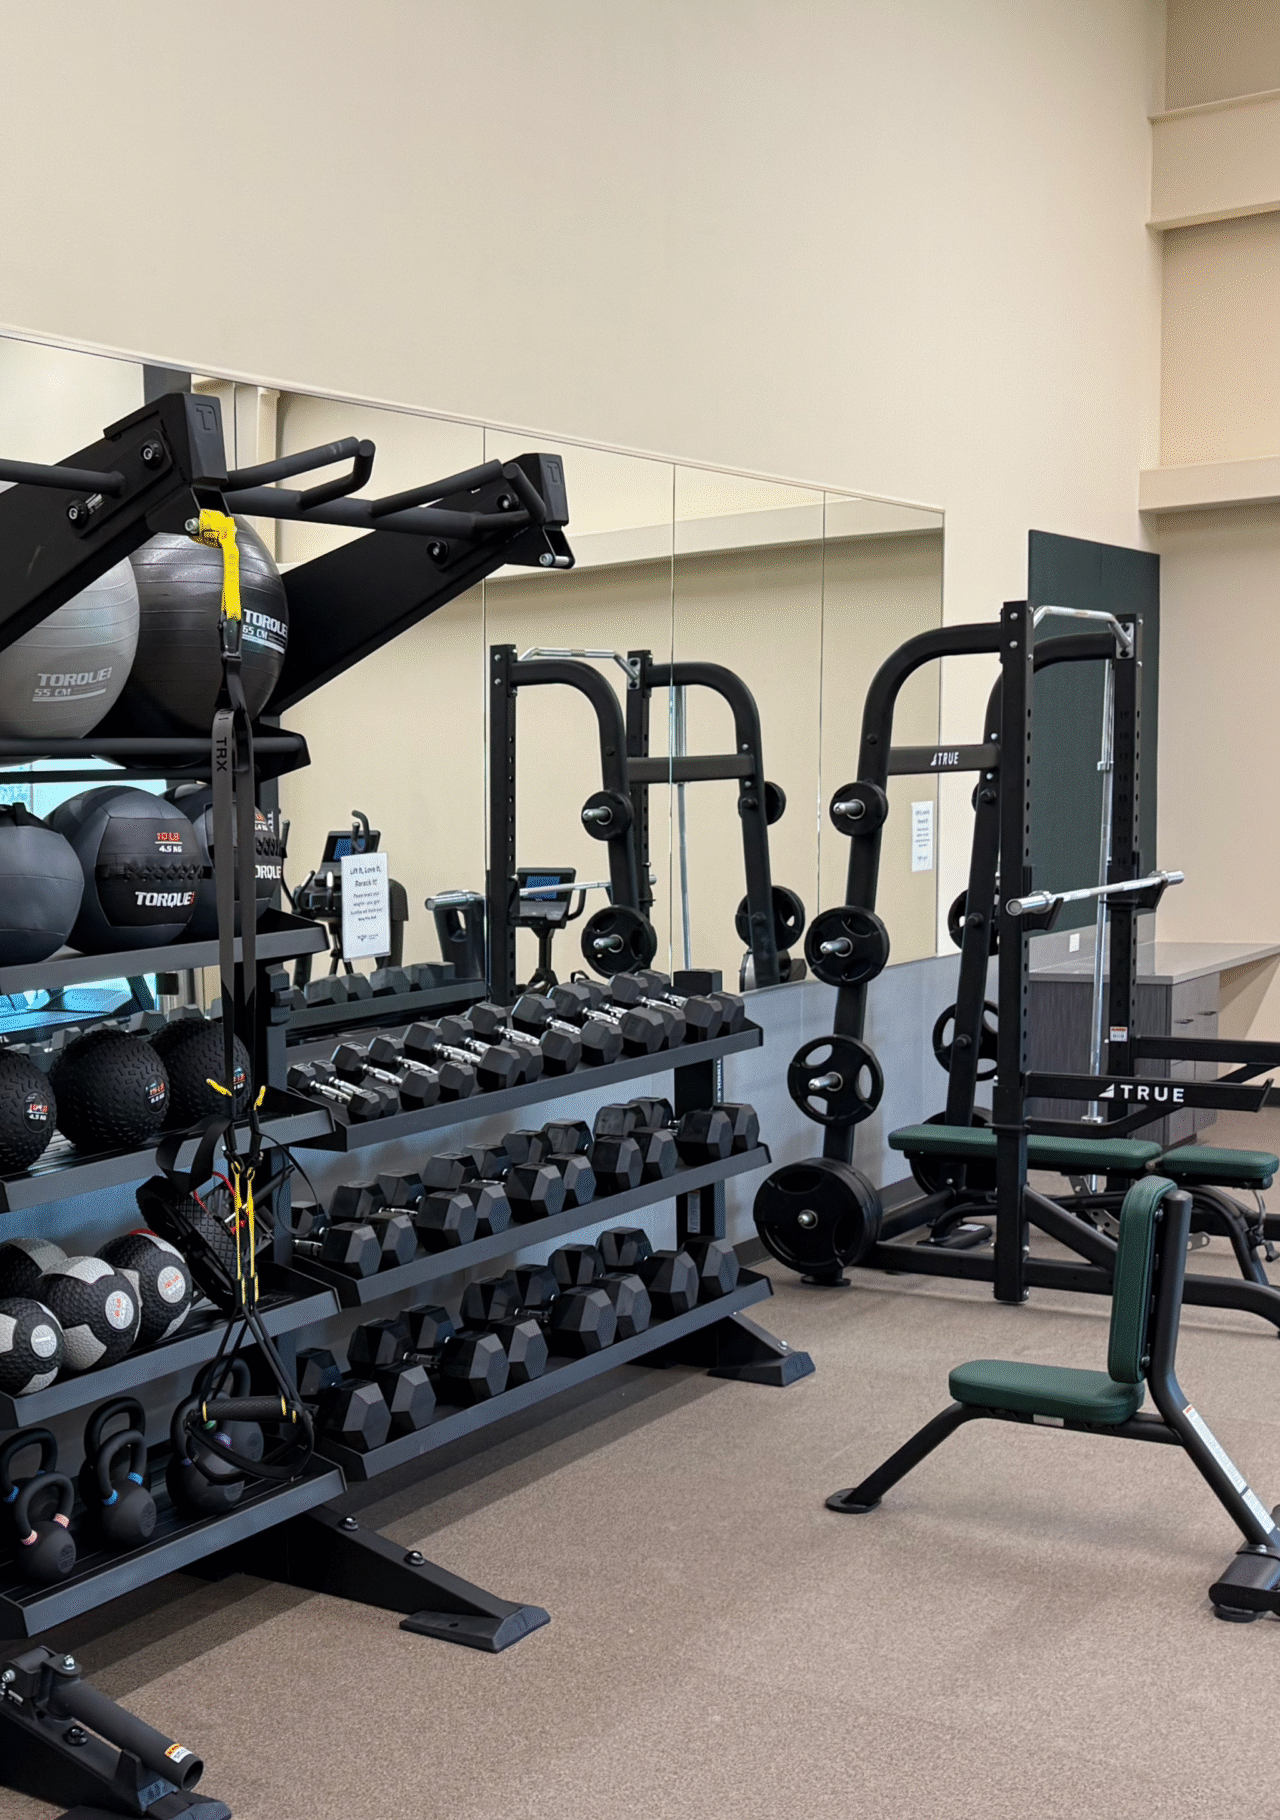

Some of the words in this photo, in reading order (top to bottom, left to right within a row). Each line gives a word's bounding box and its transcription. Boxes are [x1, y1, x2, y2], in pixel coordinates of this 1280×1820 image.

[242, 625, 253, 636] 65
[254, 628, 268, 640] CM
[37, 668, 110, 687] TORQUE
[34, 689, 51, 697] 55
[55, 688, 71, 697] CM
[216, 736, 227, 772] TRX
[938, 752, 959, 765] TRUE
[159, 845, 172, 853] 4.5
[135, 891, 191, 907] TORQUE
[1120, 1085, 1184, 1102] TRUE
